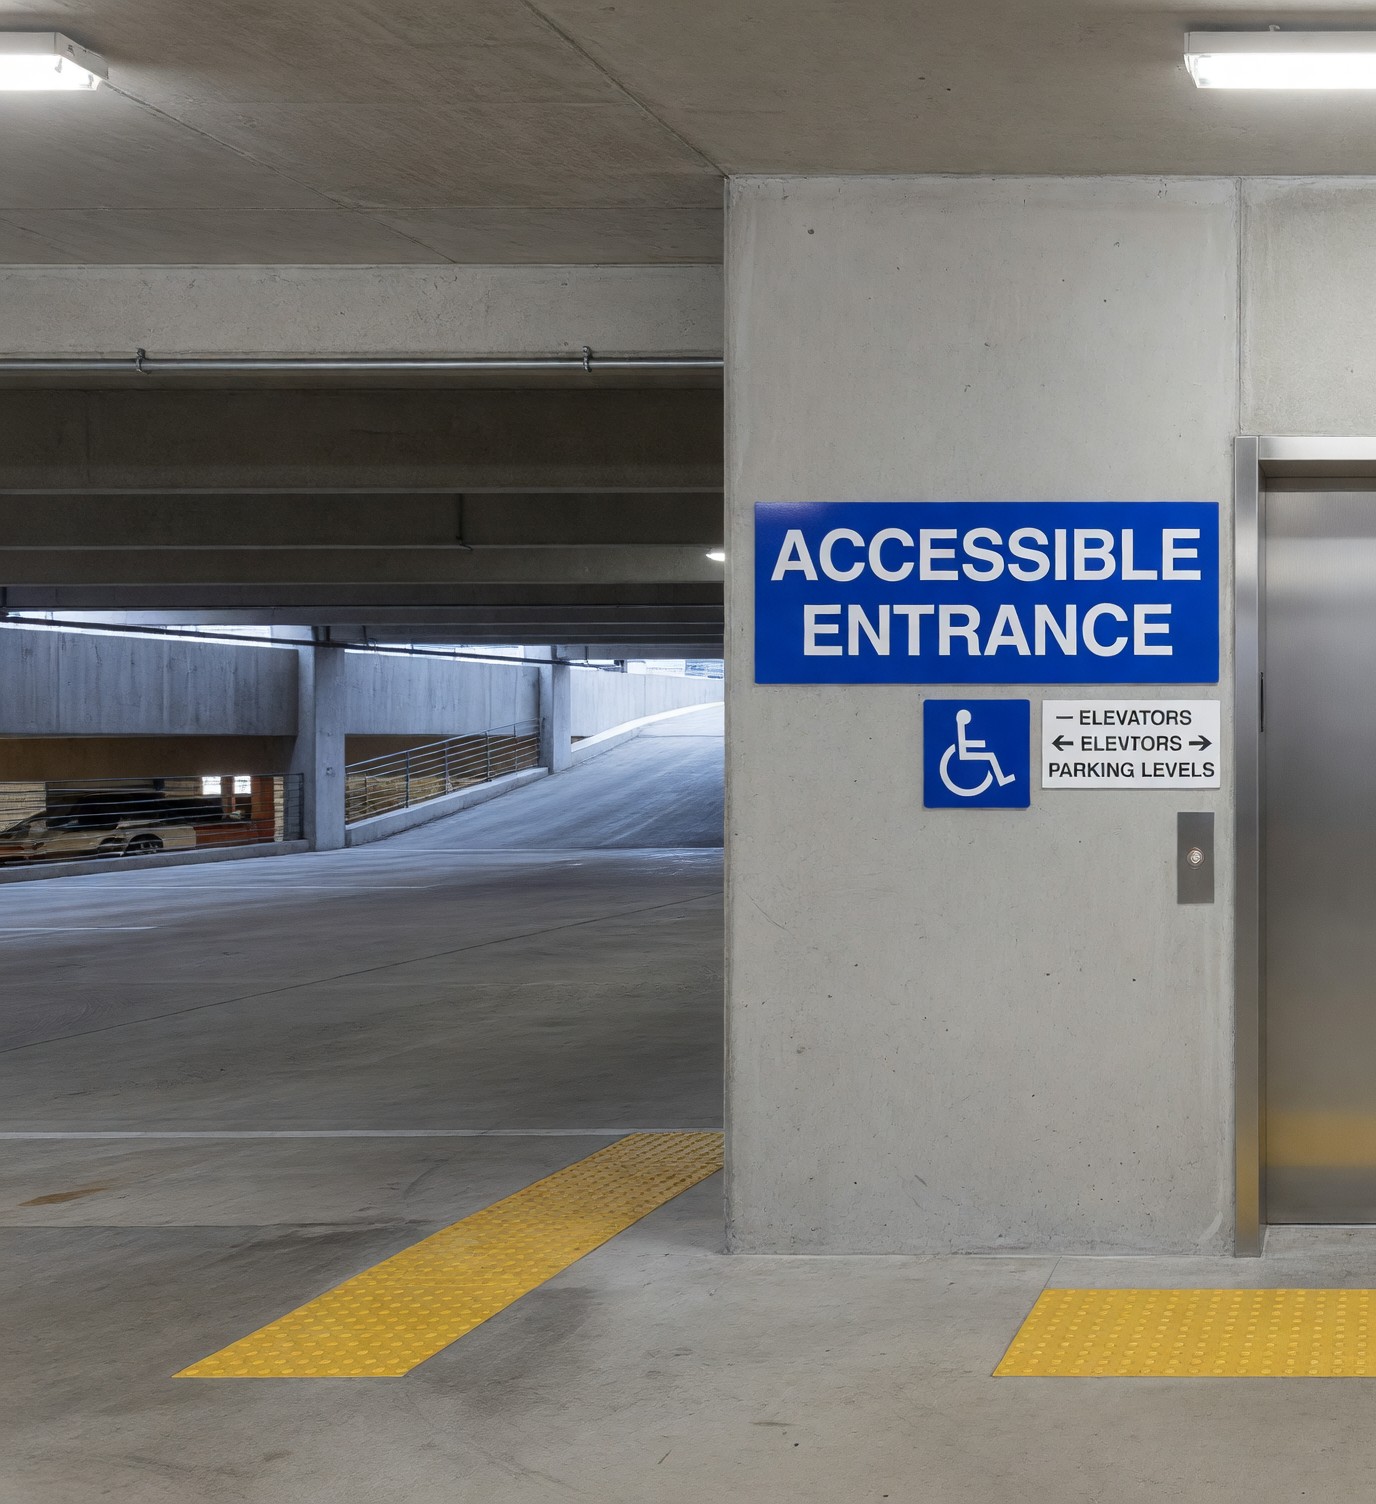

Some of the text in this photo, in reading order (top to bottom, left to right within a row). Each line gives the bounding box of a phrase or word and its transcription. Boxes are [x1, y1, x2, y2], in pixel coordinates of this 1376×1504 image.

[770, 527, 1202, 582] ACCESSIBLE
[803, 602, 1173, 657] ENTRANCE
[1079, 709, 1192, 726] ELEVATORS
[1081, 735, 1182, 751] ELEVTORS
[1048, 761, 1215, 778] PARKING LEVELS
